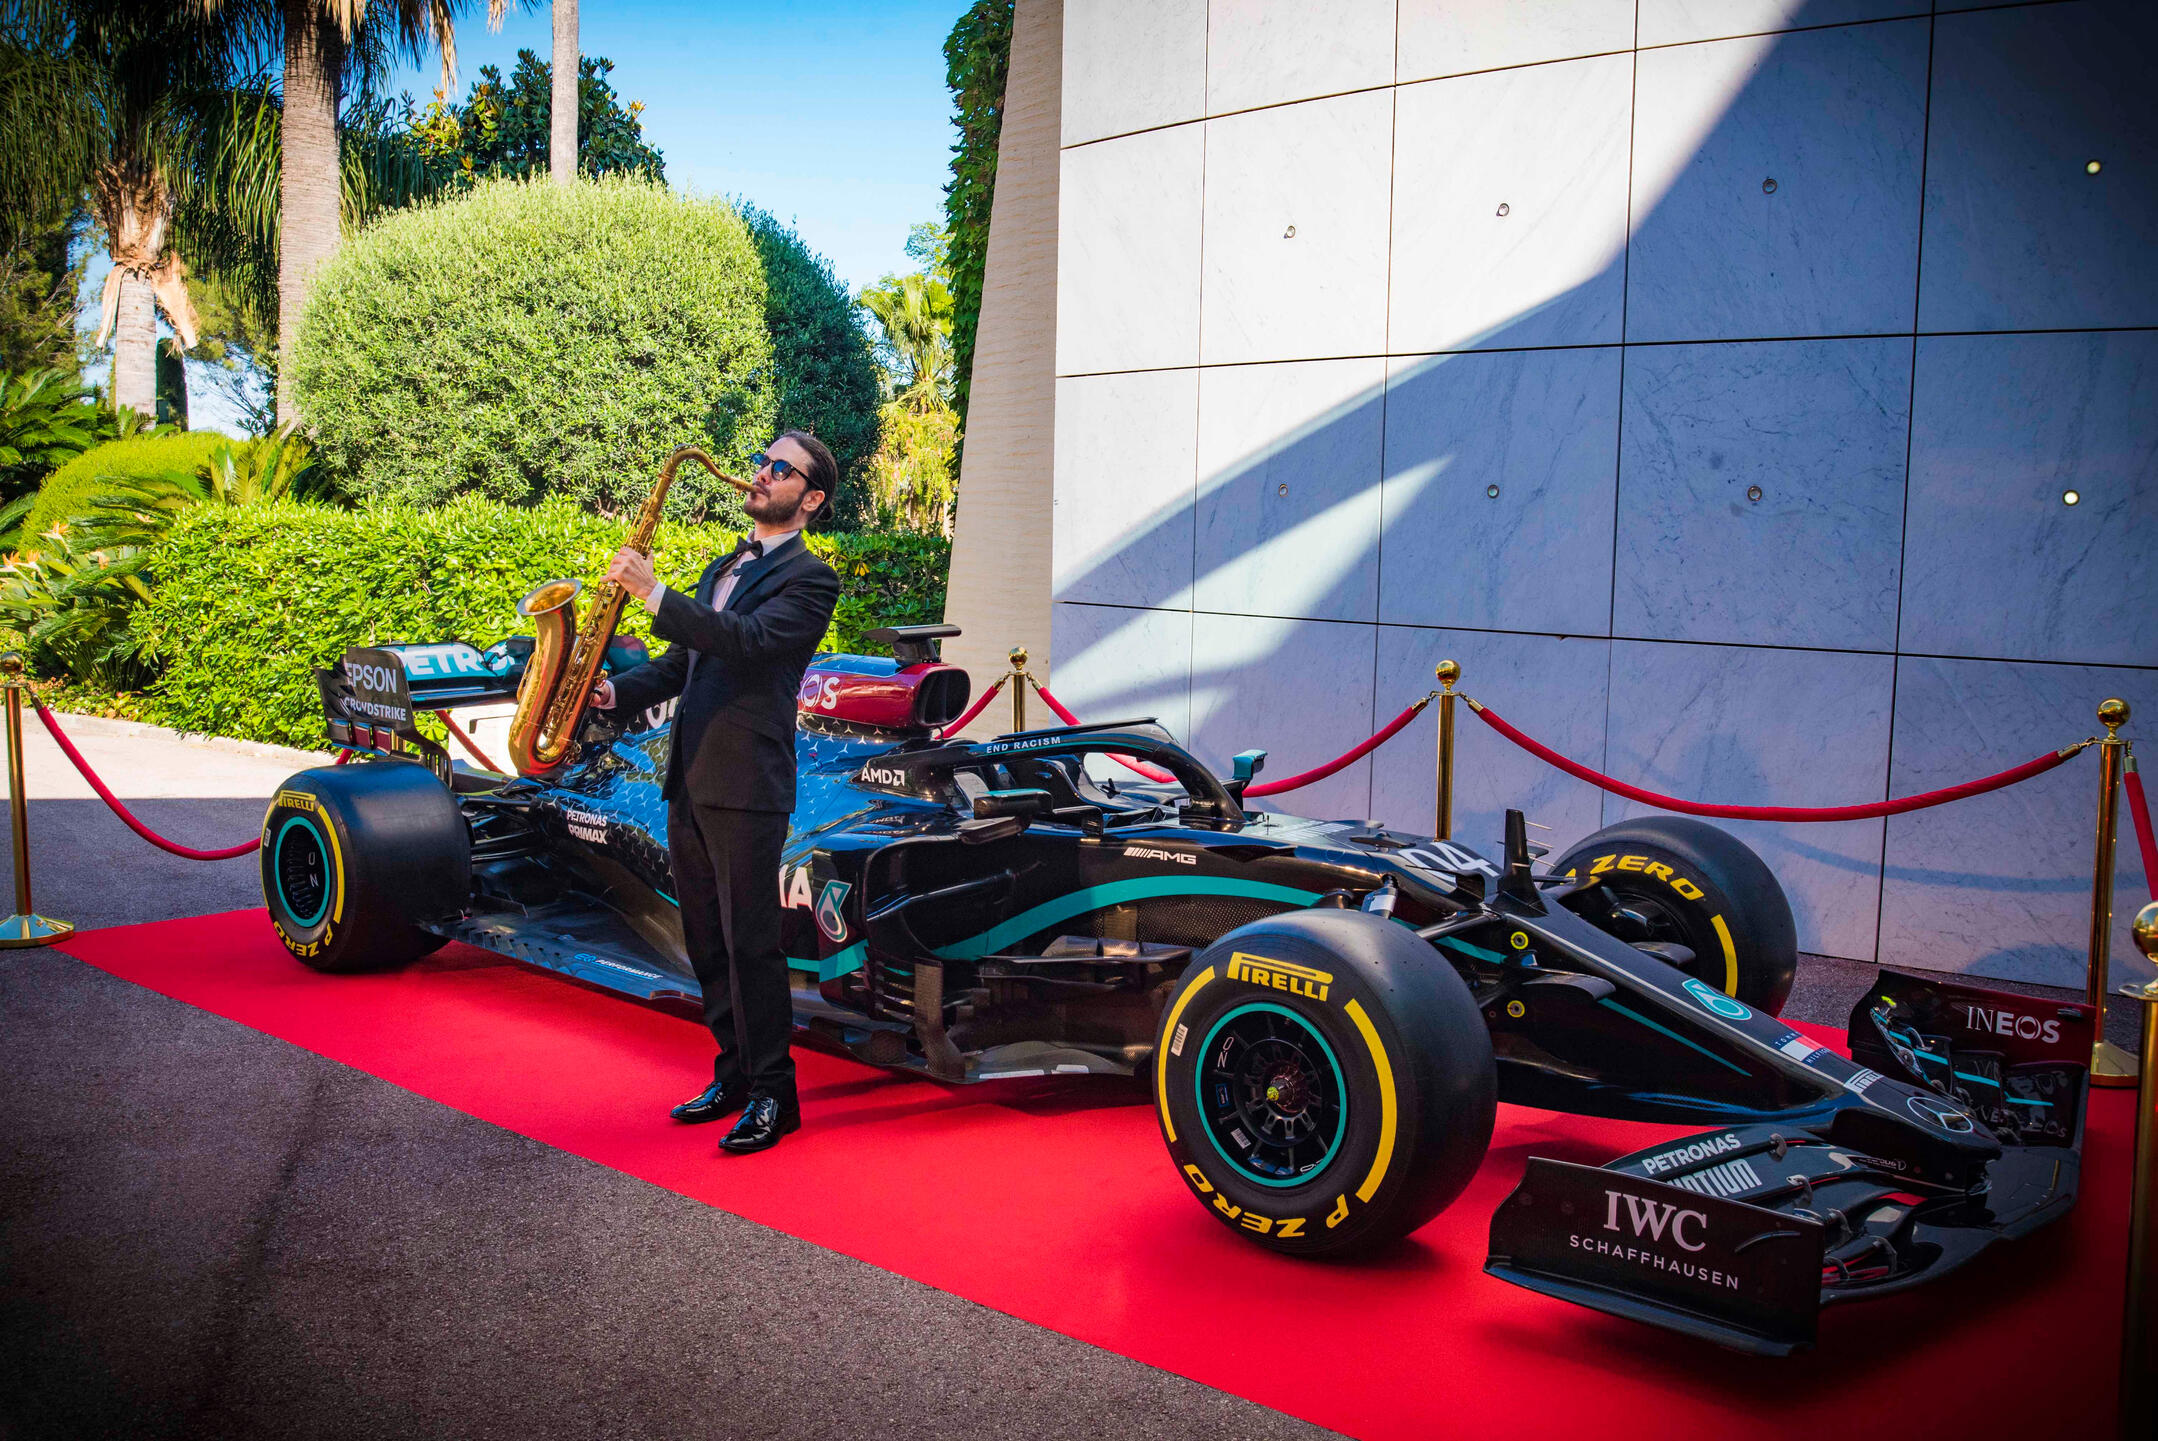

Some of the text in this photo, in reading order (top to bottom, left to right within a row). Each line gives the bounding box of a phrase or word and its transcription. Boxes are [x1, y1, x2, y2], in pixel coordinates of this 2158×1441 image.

[344, 662, 397, 693] EPSON
[986, 736, 1061, 754] END RACISM
[861, 767, 893, 785] AMD
[278, 789, 317, 812] PIRELLI
[567, 809, 608, 827] PETRONAS
[1589, 854, 1705, 901] ZERO
[273, 920, 320, 958] ZERO
[1226, 951, 1334, 1002] PIRELLI
[1966, 1005, 2061, 1043] INEOS
[1641, 1133, 1742, 1175] PETRONAS
[1183, 1164, 1350, 1238] P ZERO
[1603, 1190, 1708, 1252] IWC
[1569, 1234, 1739, 1290] SCHAFFHAUSEN
